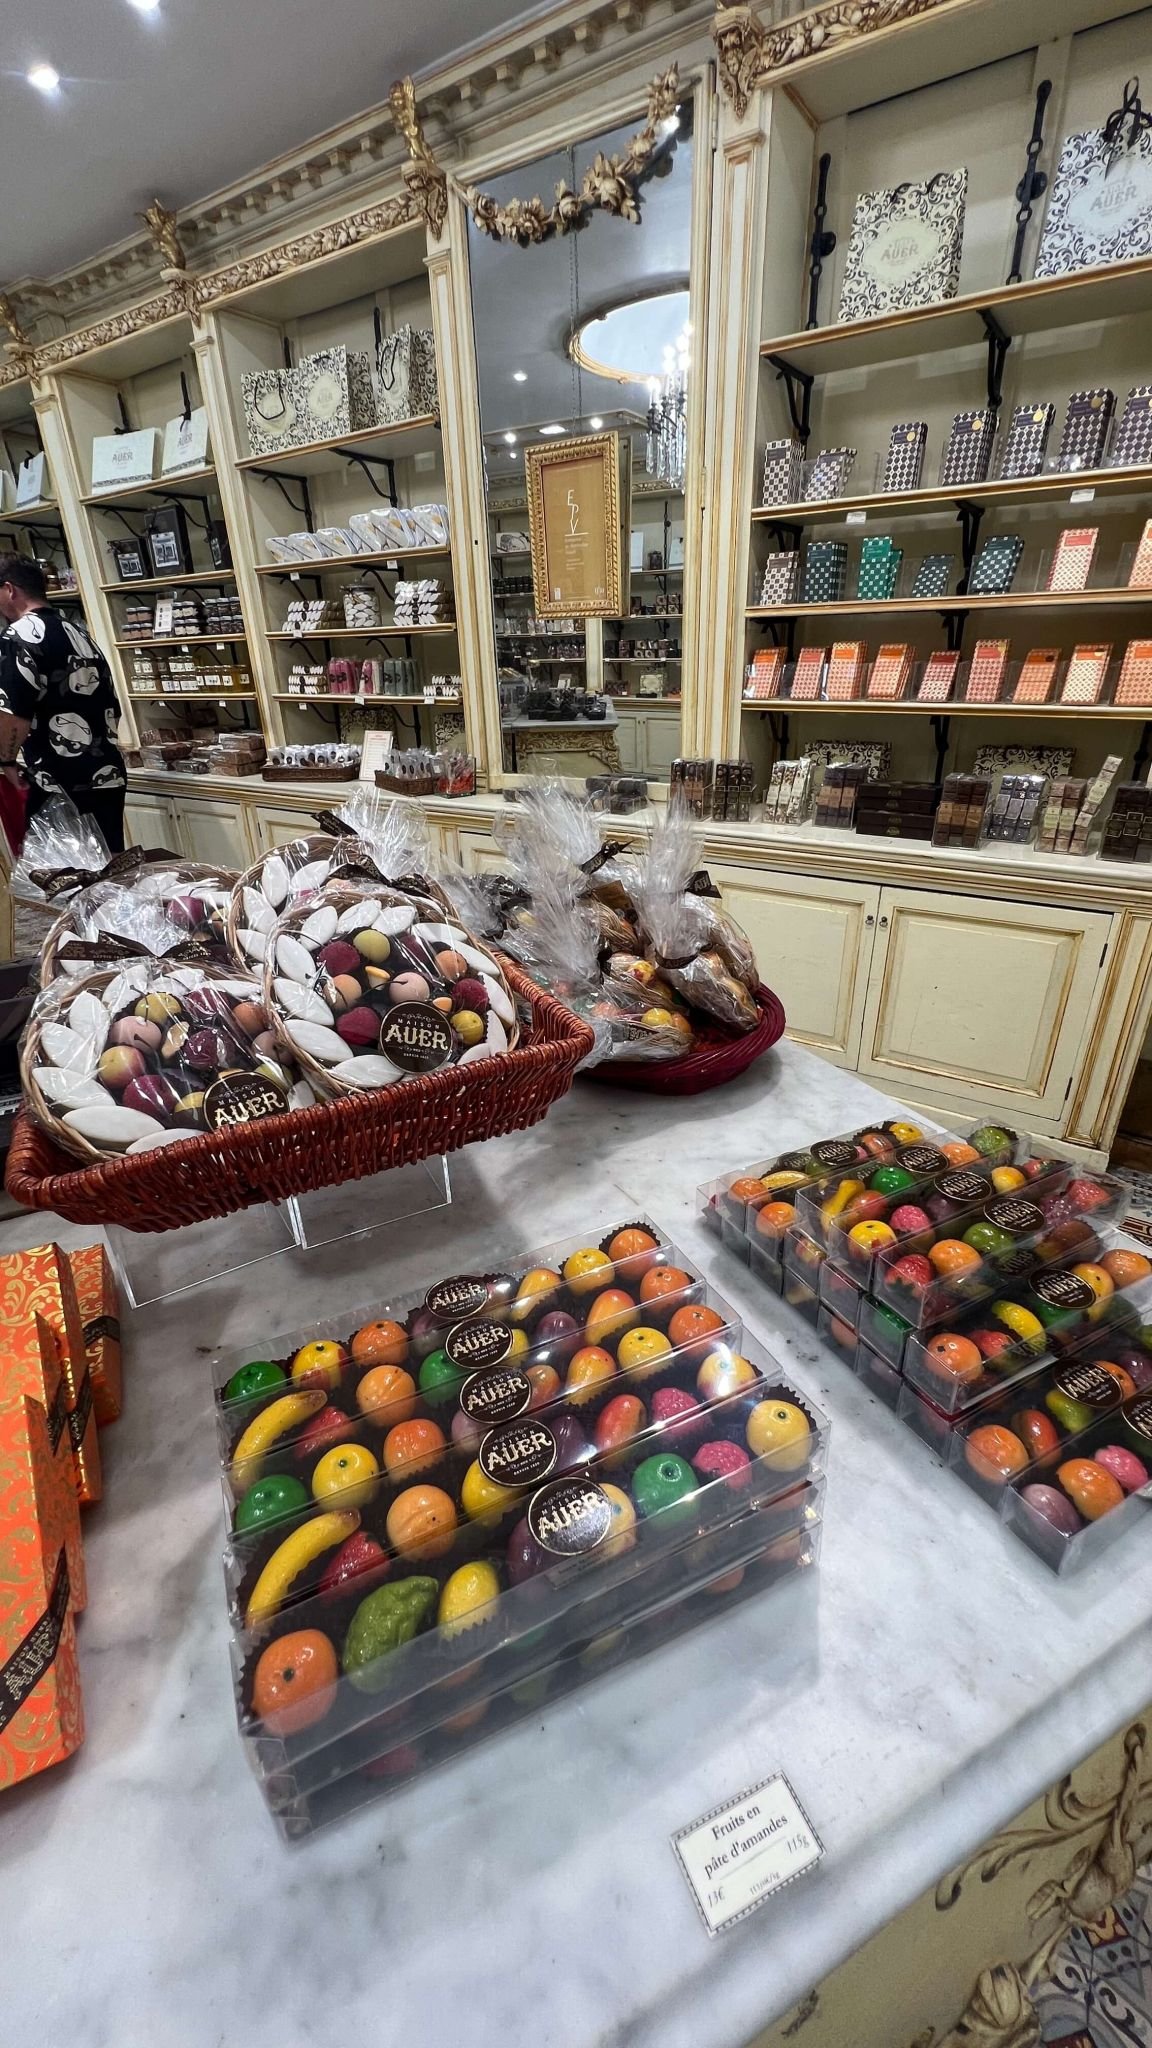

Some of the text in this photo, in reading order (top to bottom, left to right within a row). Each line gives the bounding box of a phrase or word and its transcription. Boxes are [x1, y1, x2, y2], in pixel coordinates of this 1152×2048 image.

[1089, 185, 1137, 212] AUER
[880, 243, 919, 262] AUER
[112, 451, 133, 463] AUER
[384, 1023, 449, 1051] AUER
[397, 1018, 440, 1029] MAISON
[214, 1091, 285, 1127] AUER
[218, 1086, 265, 1106] MAISON
[432, 1284, 485, 1310] AUER
[1040, 1277, 1084, 1300] AUER
[452, 1327, 509, 1358] AUER
[467, 1377, 528, 1411] AUER
[472, 1375, 512, 1394] MAISON
[1065, 1368, 1110, 1398] AUER
[487, 1432, 553, 1471] AUER
[492, 1430, 535, 1451] MAISON
[537, 1491, 609, 1540] AUER
[541, 1489, 585, 1516] MAISON
[711, 1805, 761, 1841] Fruits en
[704, 1815, 788, 1880] pâte d'amandes
[786, 1833, 810, 1854] 115g
[708, 1886, 726, 1908] 13€
